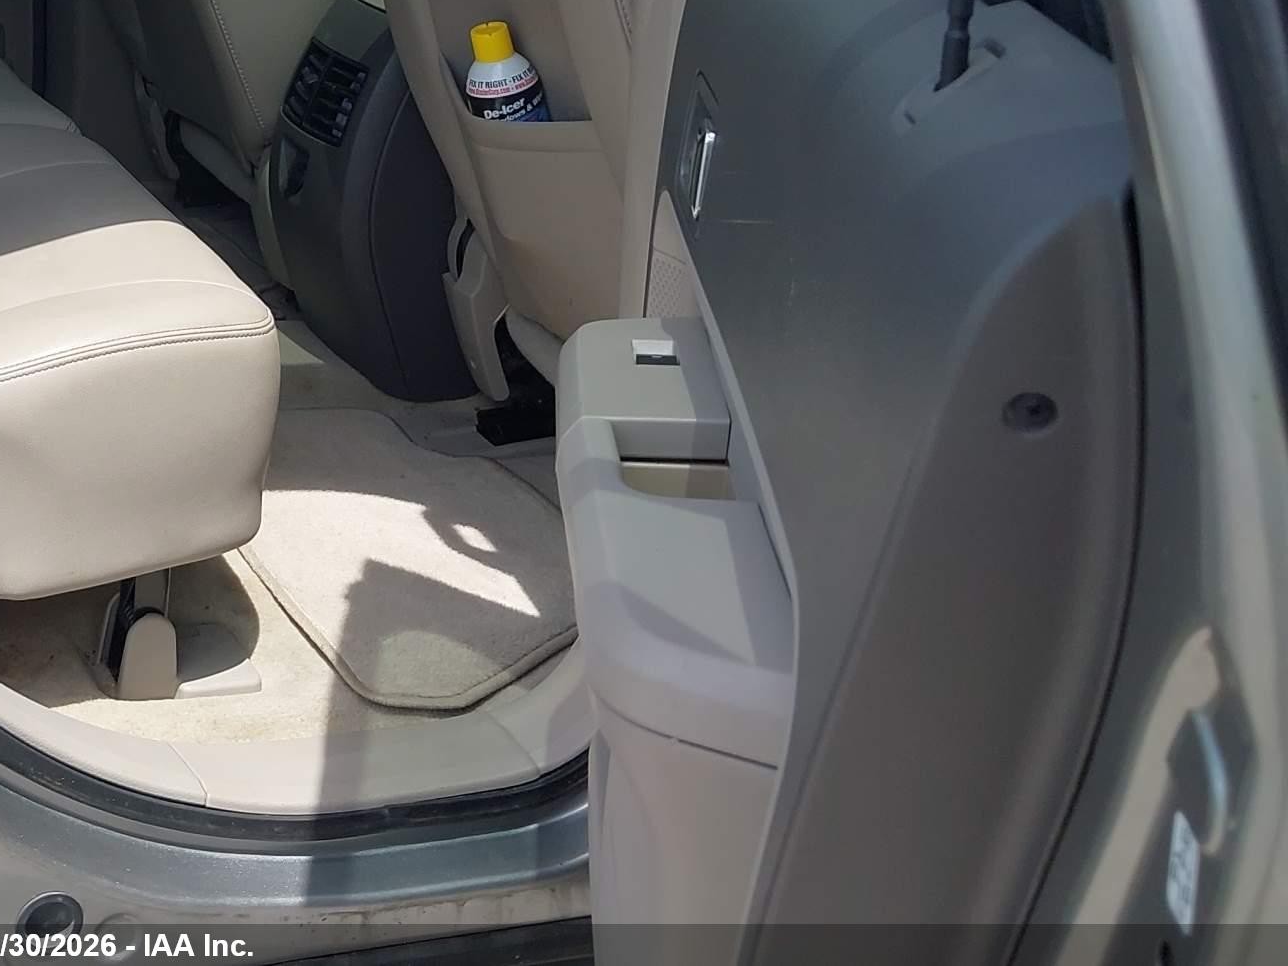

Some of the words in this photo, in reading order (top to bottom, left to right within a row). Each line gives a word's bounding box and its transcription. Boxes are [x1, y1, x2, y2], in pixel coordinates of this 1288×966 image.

[485, 79, 508, 89] RIGHT
[512, 73, 524, 83] FIX
[483, 97, 526, 120] De-Icer
